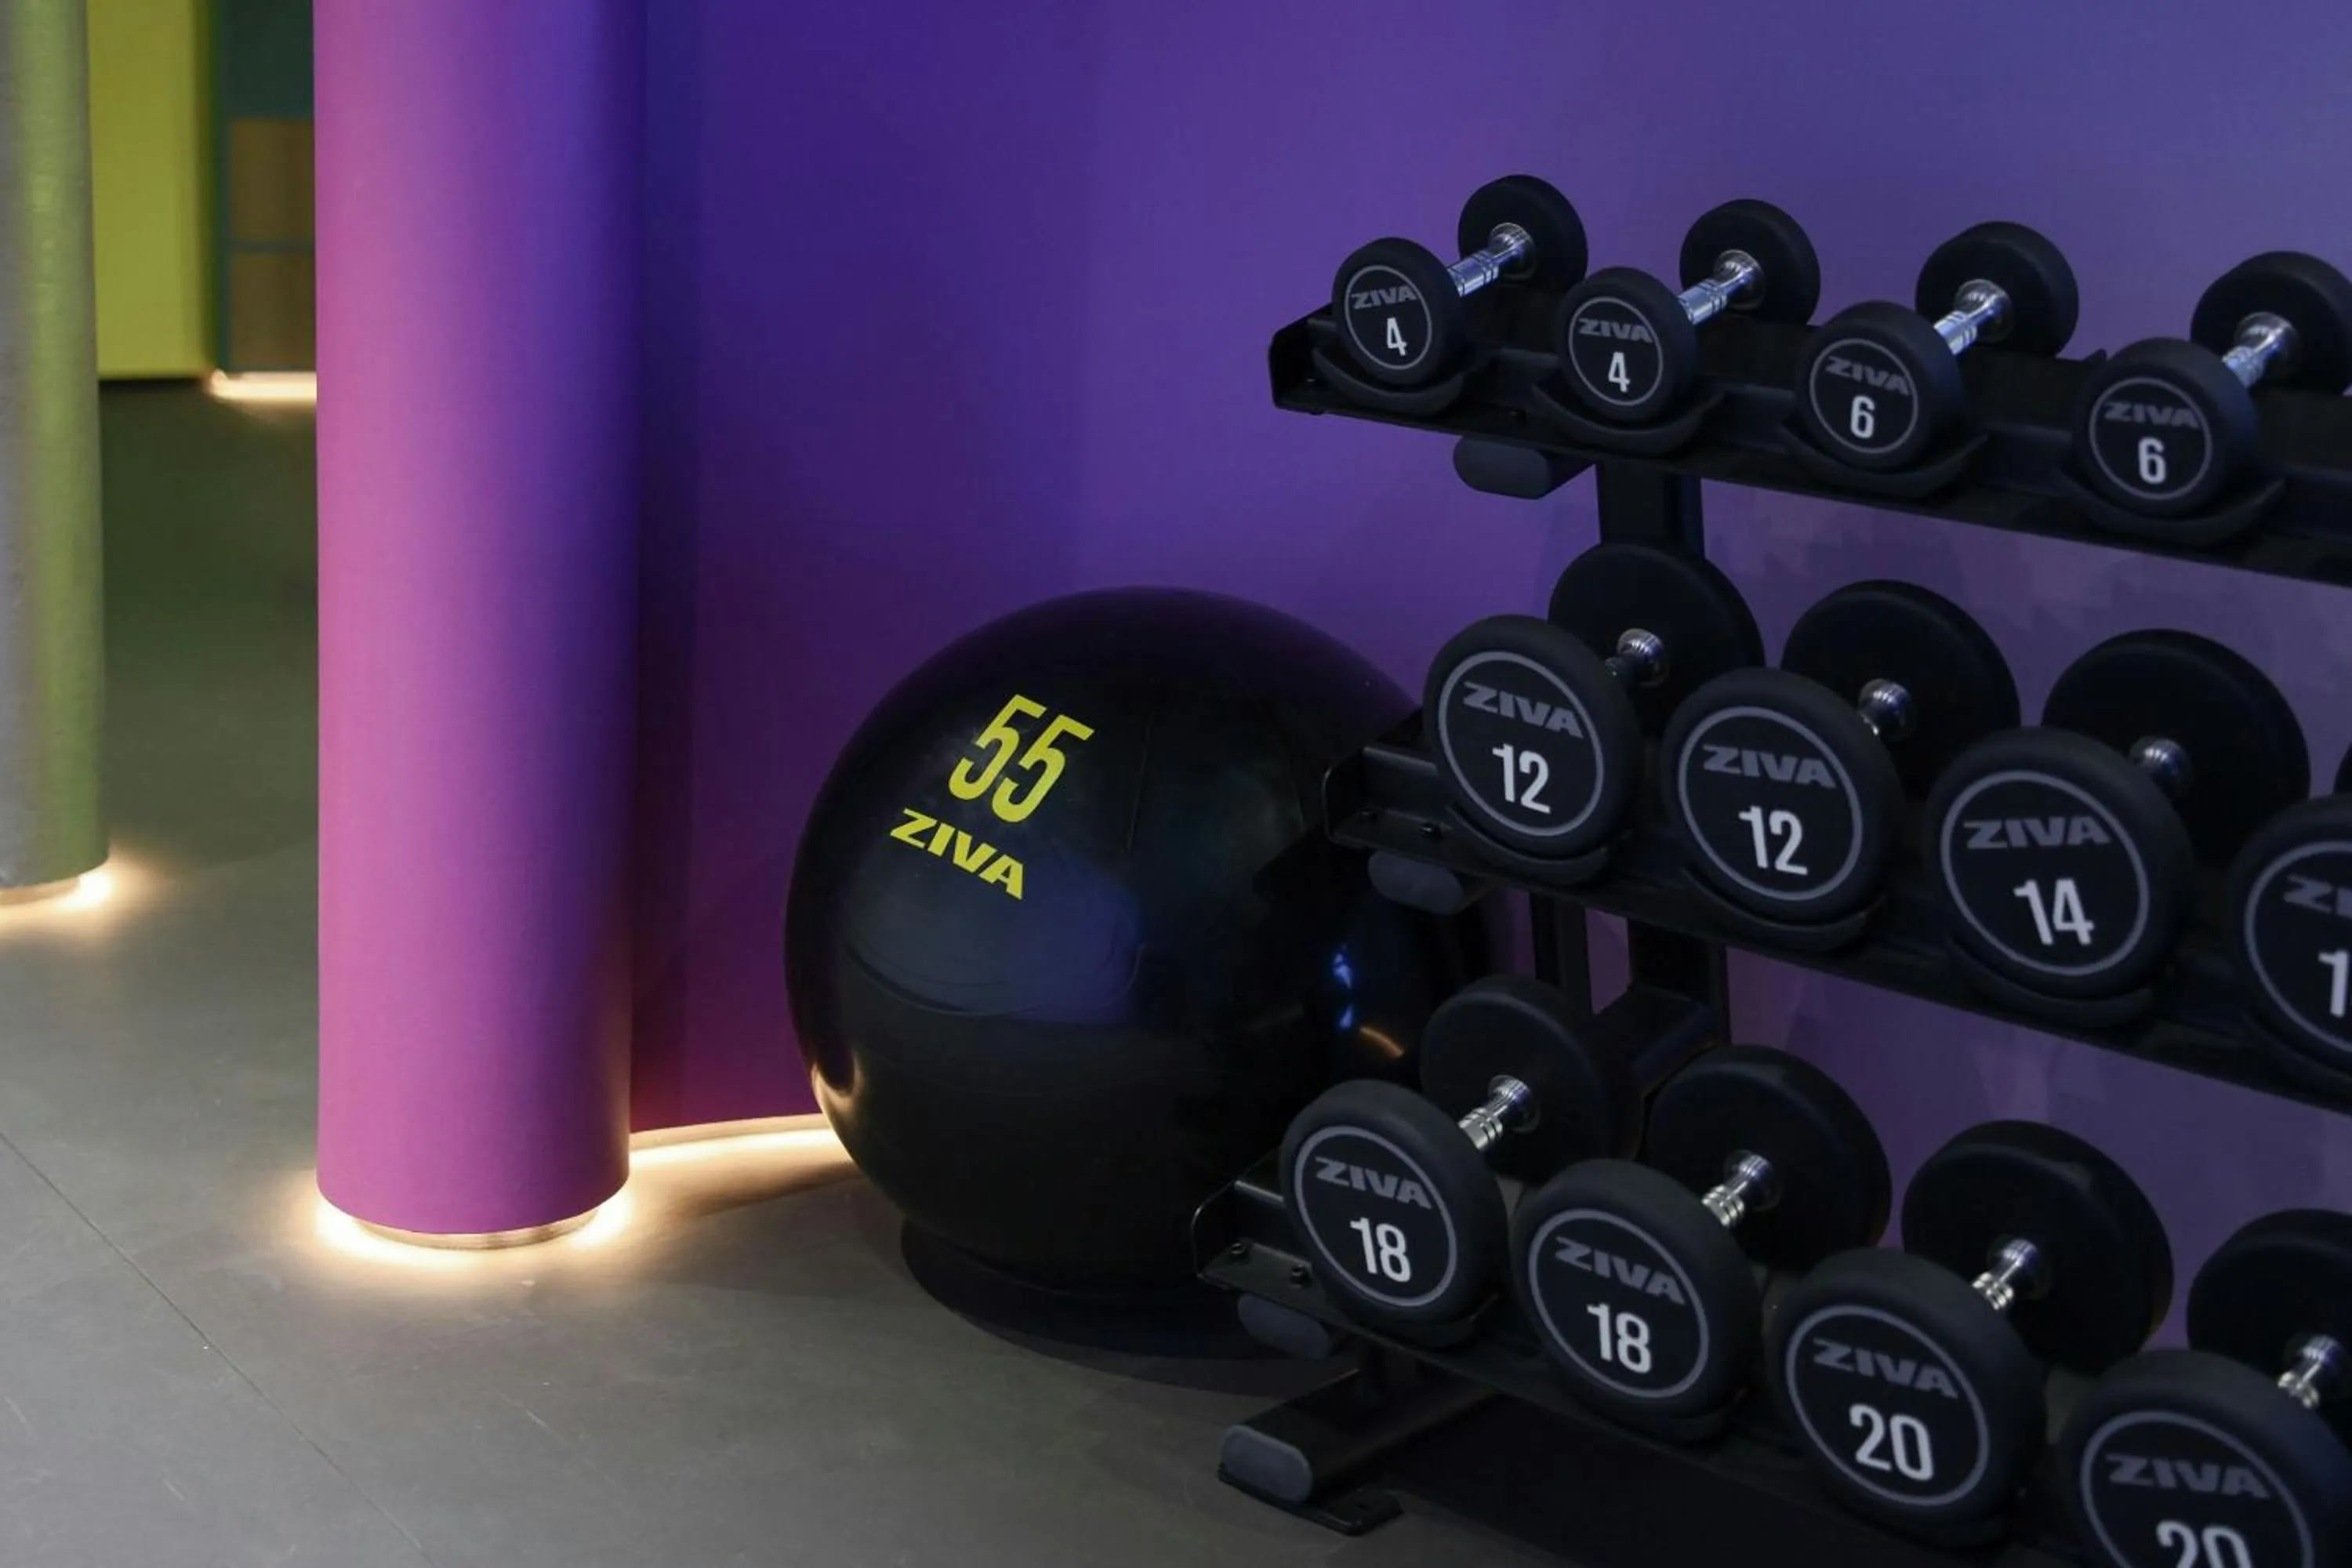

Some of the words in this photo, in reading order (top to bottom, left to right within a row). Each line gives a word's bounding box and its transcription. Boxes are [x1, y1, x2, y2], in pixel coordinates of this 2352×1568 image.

[1352, 284, 1417, 308] ZIVA
[1385, 317, 1407, 357] 4
[1578, 318, 1653, 343] ZIVA
[1607, 352, 1631, 393] 4
[1824, 354, 1911, 397] ZIVA
[1849, 395, 1875, 440] 6
[2104, 400, 2201, 429] ZIVA
[2137, 437, 2165, 485] 6
[1463, 681, 1584, 739] ZIVA
[948, 694, 1094, 823] 55
[1491, 743, 1552, 815] 12
[1701, 743, 1838, 789] ZIVA
[890, 808, 1024, 901] ZIVA
[1738, 804, 1809, 877] 12
[1962, 815, 2111, 849] ZIVA
[2012, 877, 2095, 946] 14
[2317, 949, 2352, 1018] 1
[1314, 1156, 1432, 1210] ZIVA
[1349, 1217, 1412, 1283] 18
[1554, 1236, 1686, 1305] ZIVA
[1586, 1302, 1653, 1374] 18
[1813, 1338, 1958, 1400] ZIVA
[1848, 1403, 1934, 1482] 20
[2105, 1452, 2271, 1500] ZIVA
[2154, 1519, 2255, 1568] 20
